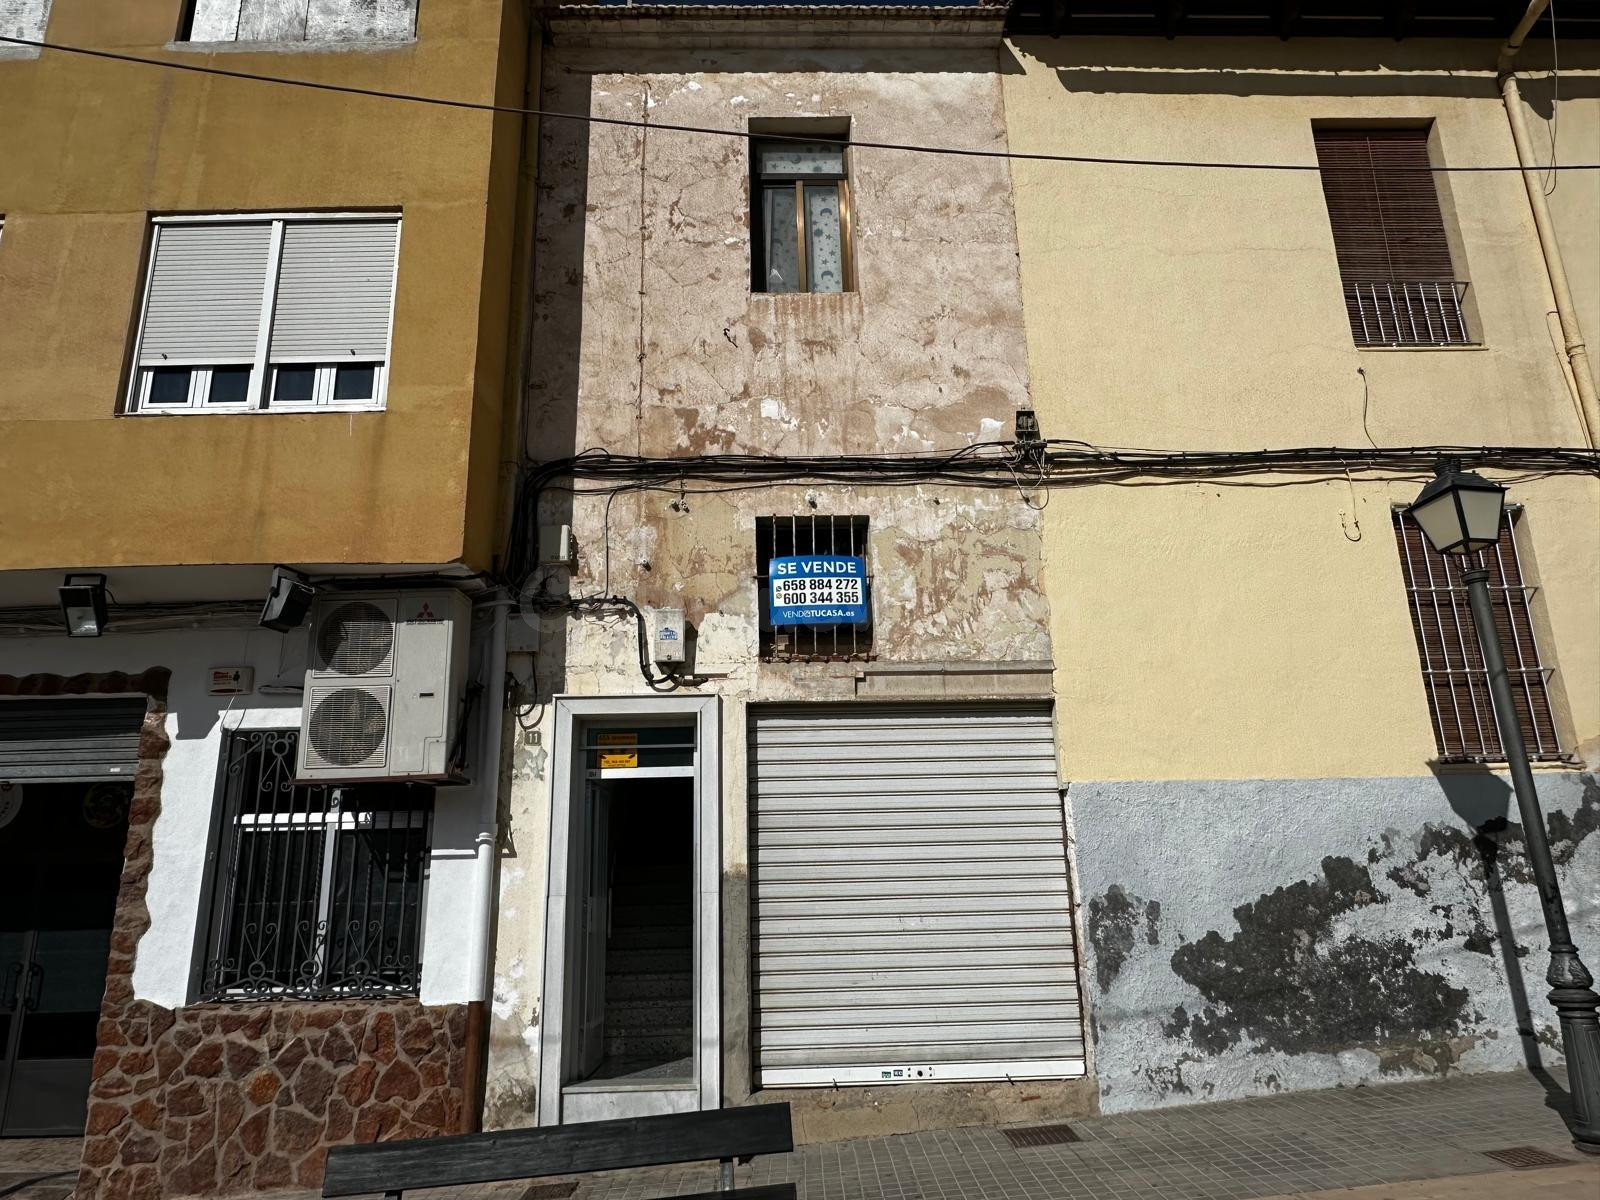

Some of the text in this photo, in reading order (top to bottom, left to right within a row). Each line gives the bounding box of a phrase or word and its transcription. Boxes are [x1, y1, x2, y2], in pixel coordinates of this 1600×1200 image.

[777, 561, 857, 575] SE VENDE
[783, 578, 858, 591] 658 884 272
[783, 591, 859, 605] 600 344 355
